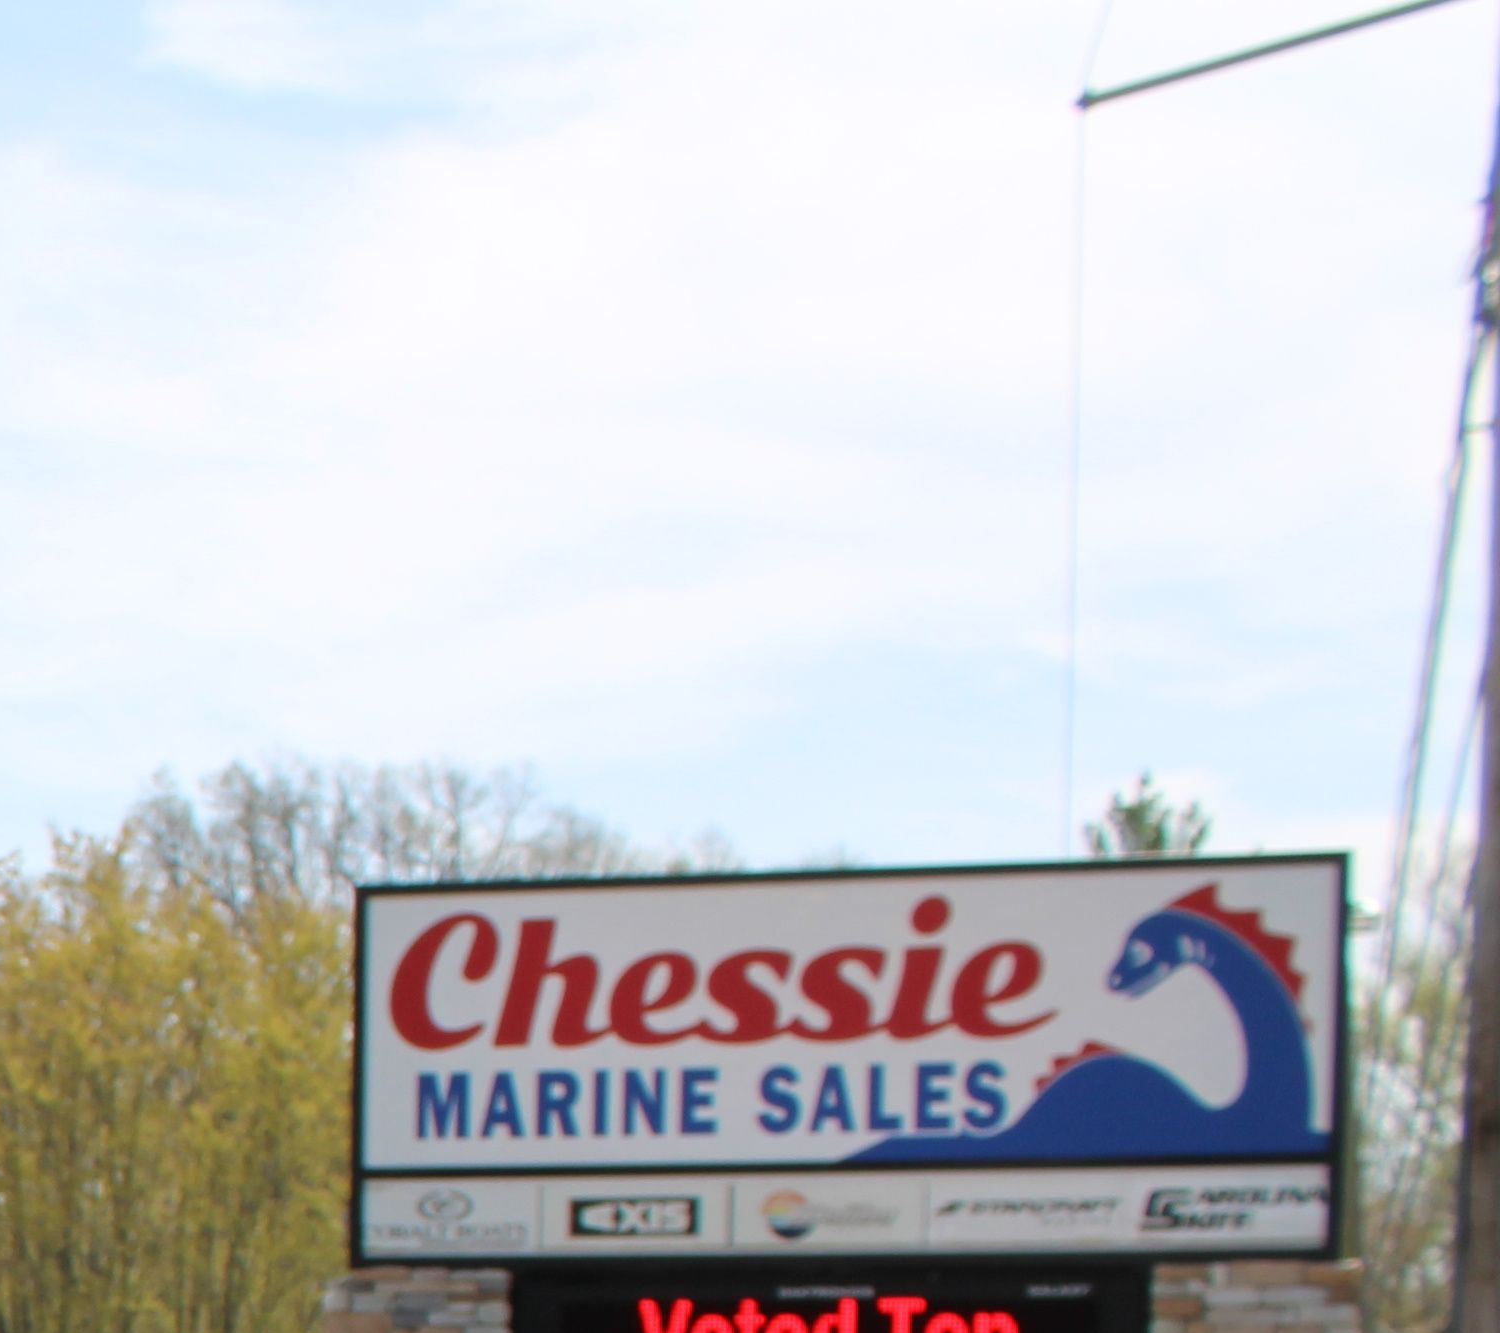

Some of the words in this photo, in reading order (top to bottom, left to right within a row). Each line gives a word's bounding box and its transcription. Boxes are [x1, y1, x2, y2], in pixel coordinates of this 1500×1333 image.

[388, 896, 1059, 1050] Chessie
[416, 1066, 720, 1141] MARINE
[755, 1058, 1008, 1134] SALES
